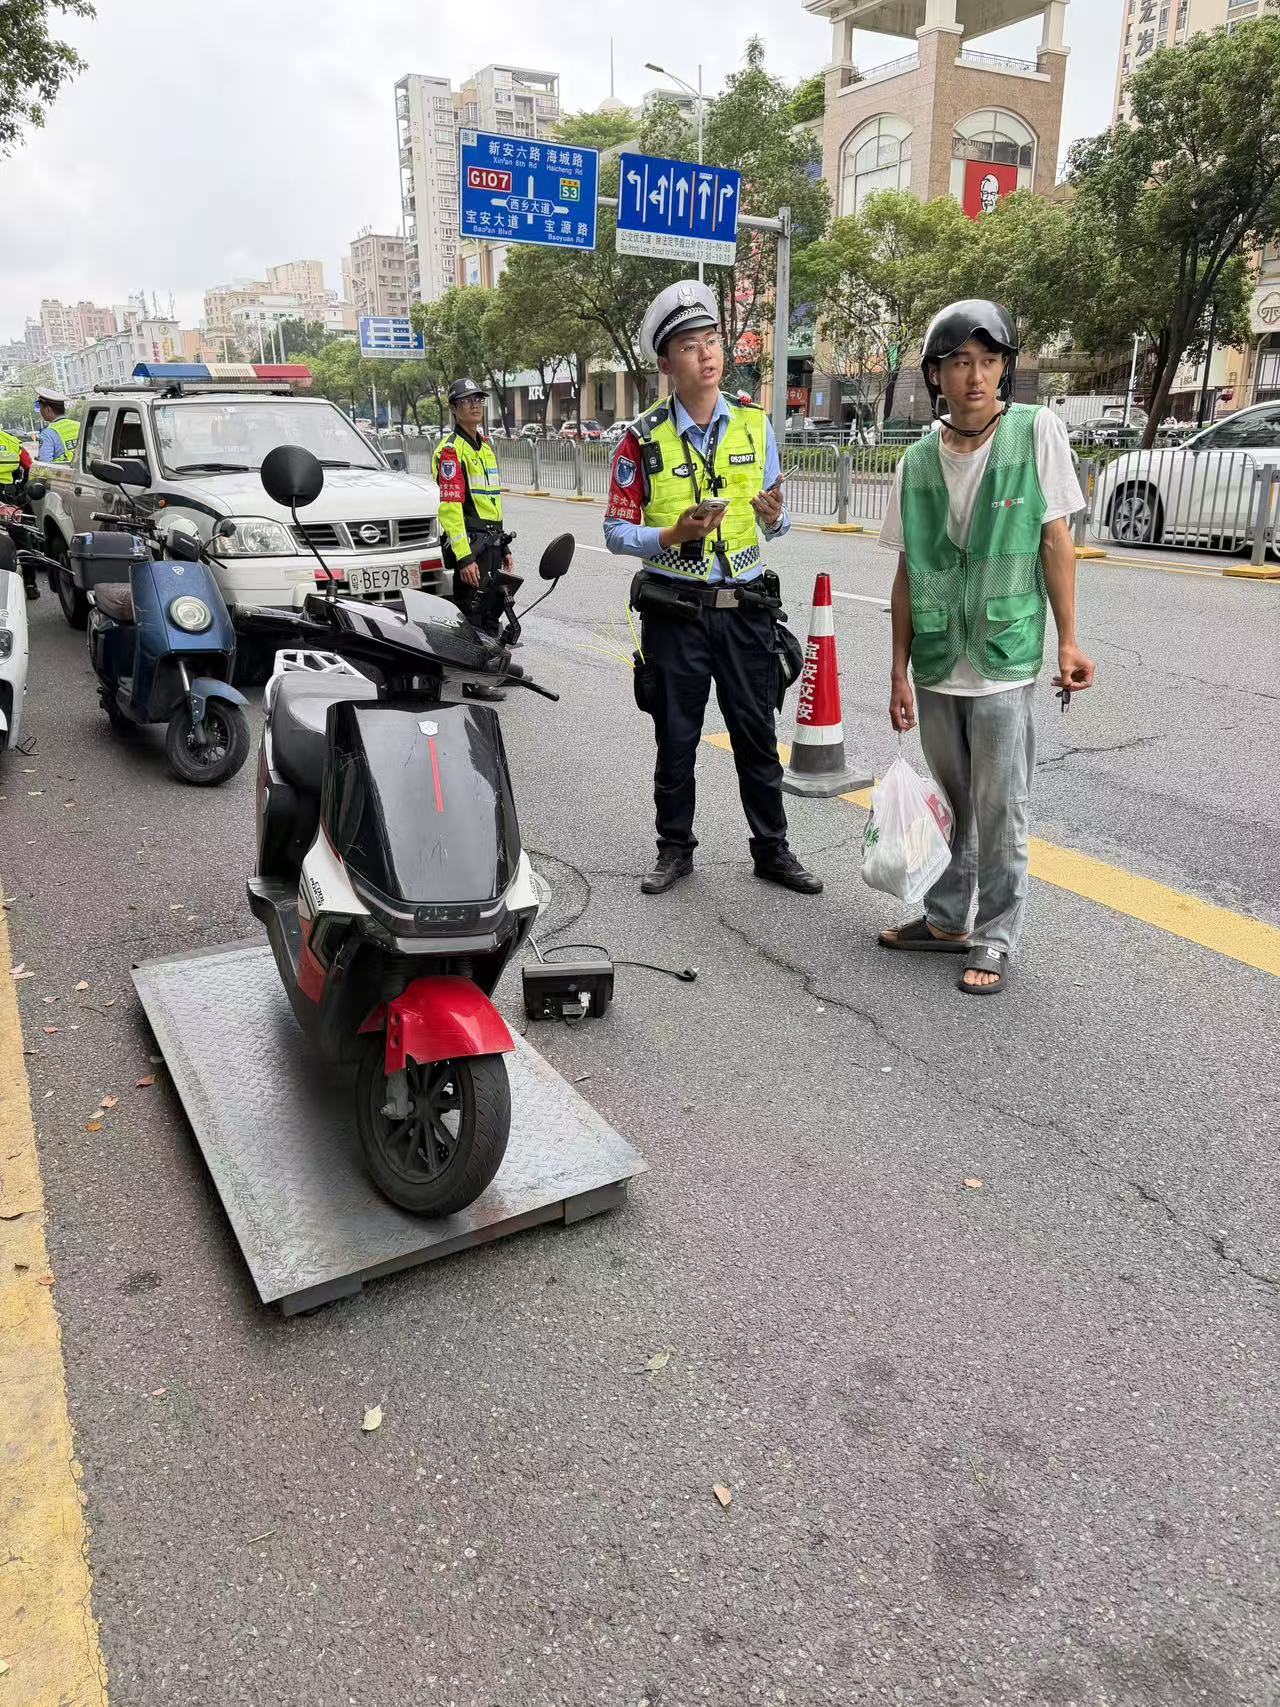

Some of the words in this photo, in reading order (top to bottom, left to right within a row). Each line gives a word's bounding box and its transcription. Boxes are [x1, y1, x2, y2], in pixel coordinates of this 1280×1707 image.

[489, 141, 540, 161] 新安六路
[546, 149, 583, 168] 海城路
[546, 164, 572, 175] Haicheng
[575, 168, 583, 176] Rd
[470, 171, 509, 189] G107
[562, 186, 577, 198] S3
[510, 200, 551, 215] 西乡大道
[466, 210, 519, 229] 宝安大道
[498, 227, 513, 236] Blvd
[544, 220, 588, 236] 宝源路
[548, 233, 574, 243] Baoyuan
[576, 236, 585, 244] Rd
[528, 385, 545, 400] KFC
[730, 454, 754, 463] 052807
[610, 494, 637, 509] 安大队
